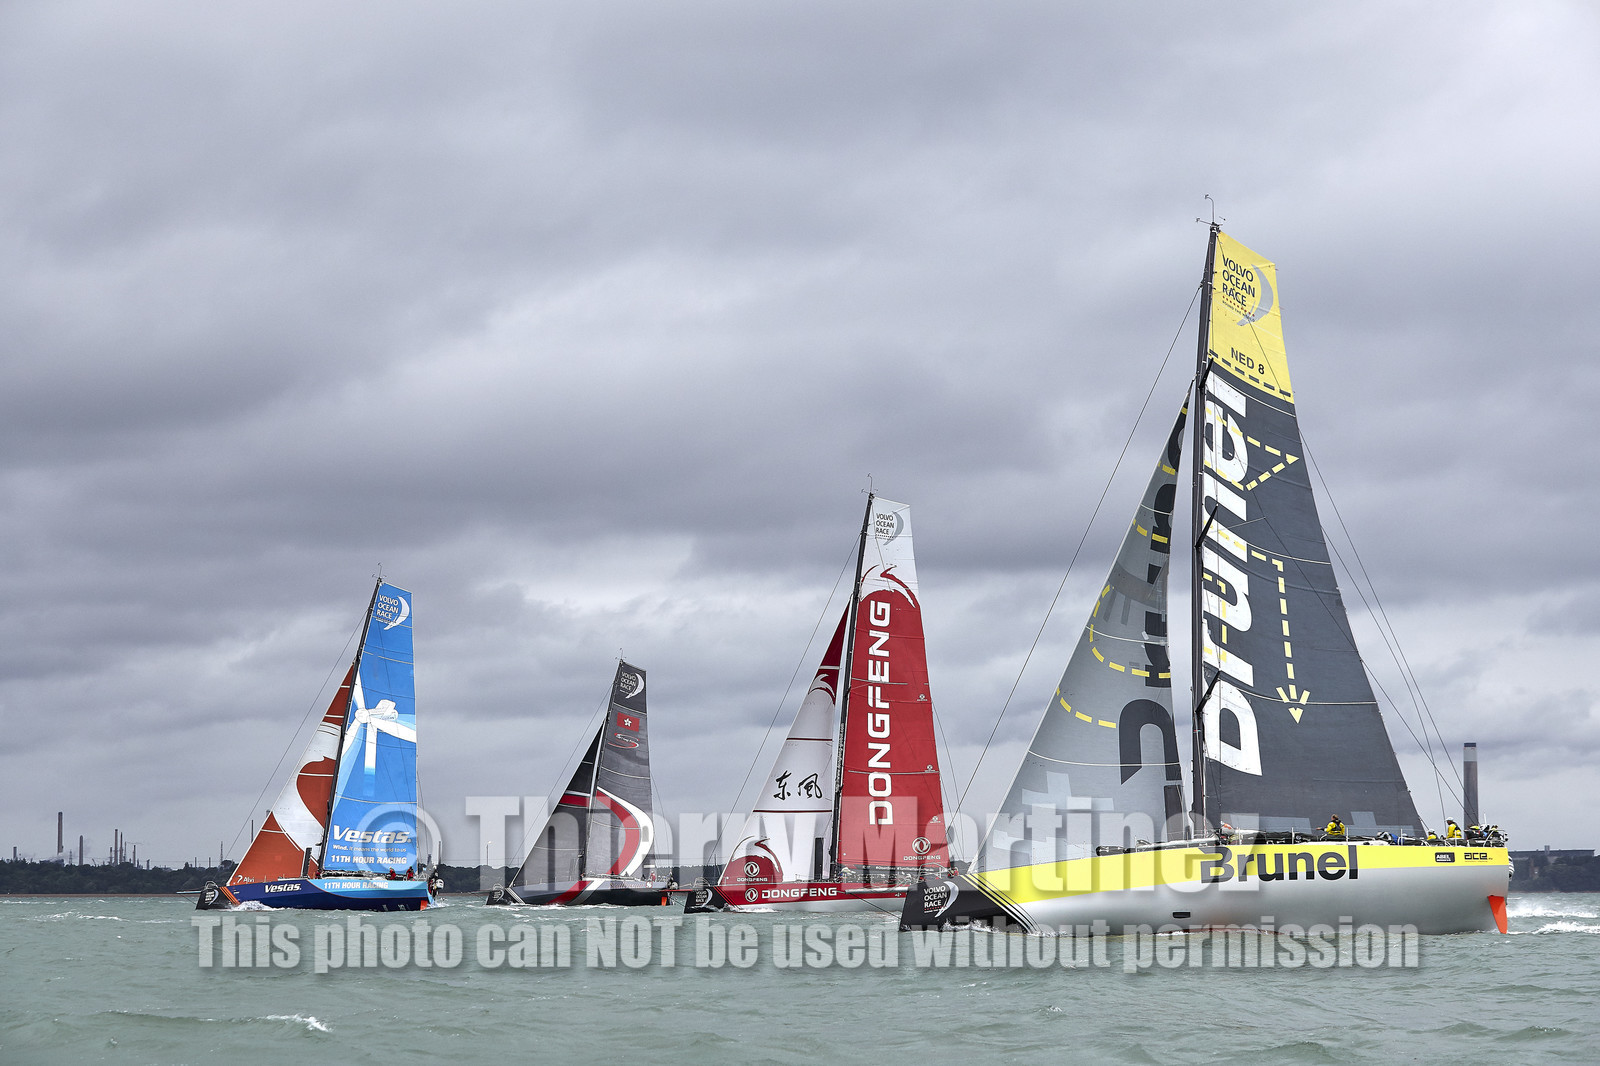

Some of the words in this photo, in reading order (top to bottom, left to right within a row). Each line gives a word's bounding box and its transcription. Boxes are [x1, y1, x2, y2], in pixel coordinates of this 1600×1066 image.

[1222, 254, 1254, 282] VOLVO
[1222, 269, 1256, 298] OCEAN
[1222, 282, 1247, 307] RACE
[1230, 347, 1255, 369] NED
[1258, 363, 1265, 375] 8
[876, 513, 894, 521] VOLVO
[876, 520, 894, 529] OCEAN
[379, 595, 399, 606] VOLVO
[377, 602, 399, 614] OCEAN
[376, 609, 392, 620] RACE
[622, 671, 637, 680] VOLVO
[621, 677, 637, 687] OCEAN
[867, 600, 893, 825] DONGFENG
[331, 854, 351, 863] 11TH
[352, 855, 374, 864] HOUR
[376, 856, 407, 865] RACING
[1198, 845, 1358, 884] Brunel
[362, 881, 389, 889] RACING
[923, 885, 946, 895] VOLVO
[761, 887, 837, 899] DONGFENG
[923, 892, 948, 902] OCEAN
[923, 900, 942, 908] RACE
